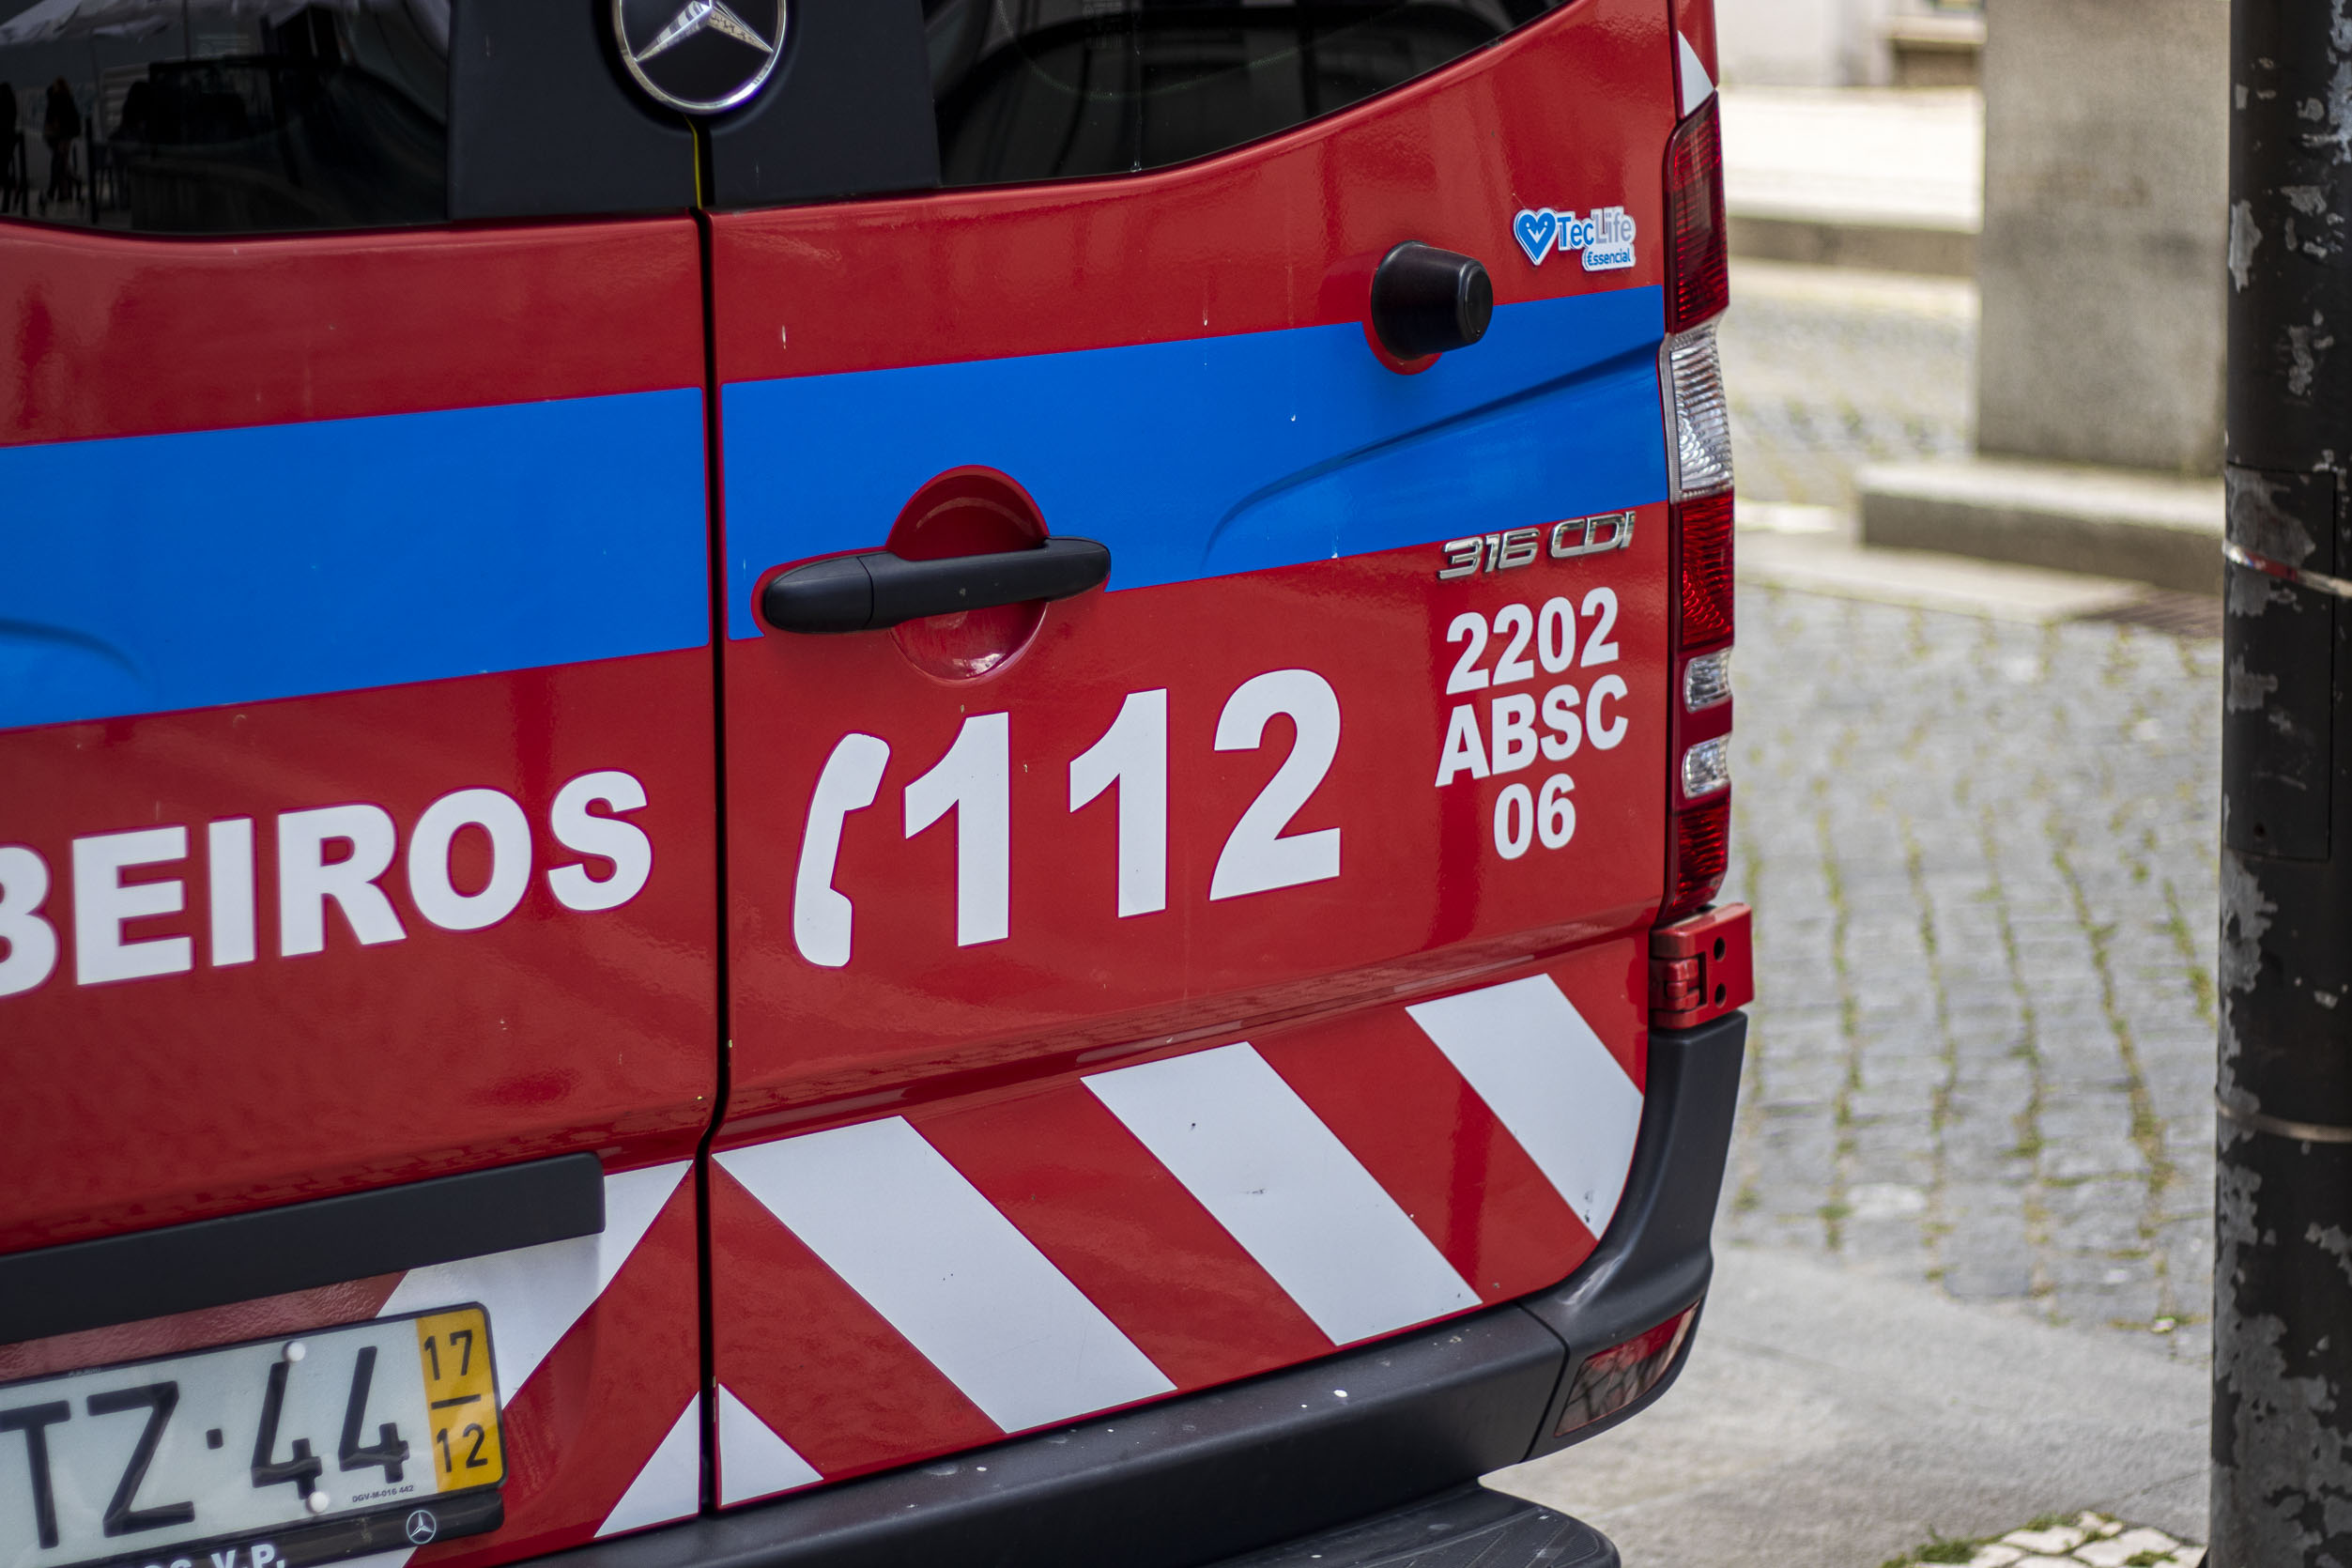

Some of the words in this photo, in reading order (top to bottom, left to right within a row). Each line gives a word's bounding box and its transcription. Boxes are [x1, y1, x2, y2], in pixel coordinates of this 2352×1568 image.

[1557, 212, 1633, 249] TecLife
[1587, 248, 1632, 266] Essencial
[1438, 528, 1541, 580] 316
[1550, 511, 1637, 560] CDI
[1446, 586, 1620, 696] 2202
[1435, 673, 1629, 788] ABSC
[904, 669, 1342, 948] 112
[1493, 773, 1576, 860] 06
[424, 1329, 473, 1381] 17
[436, 1422, 488, 1473] 12
